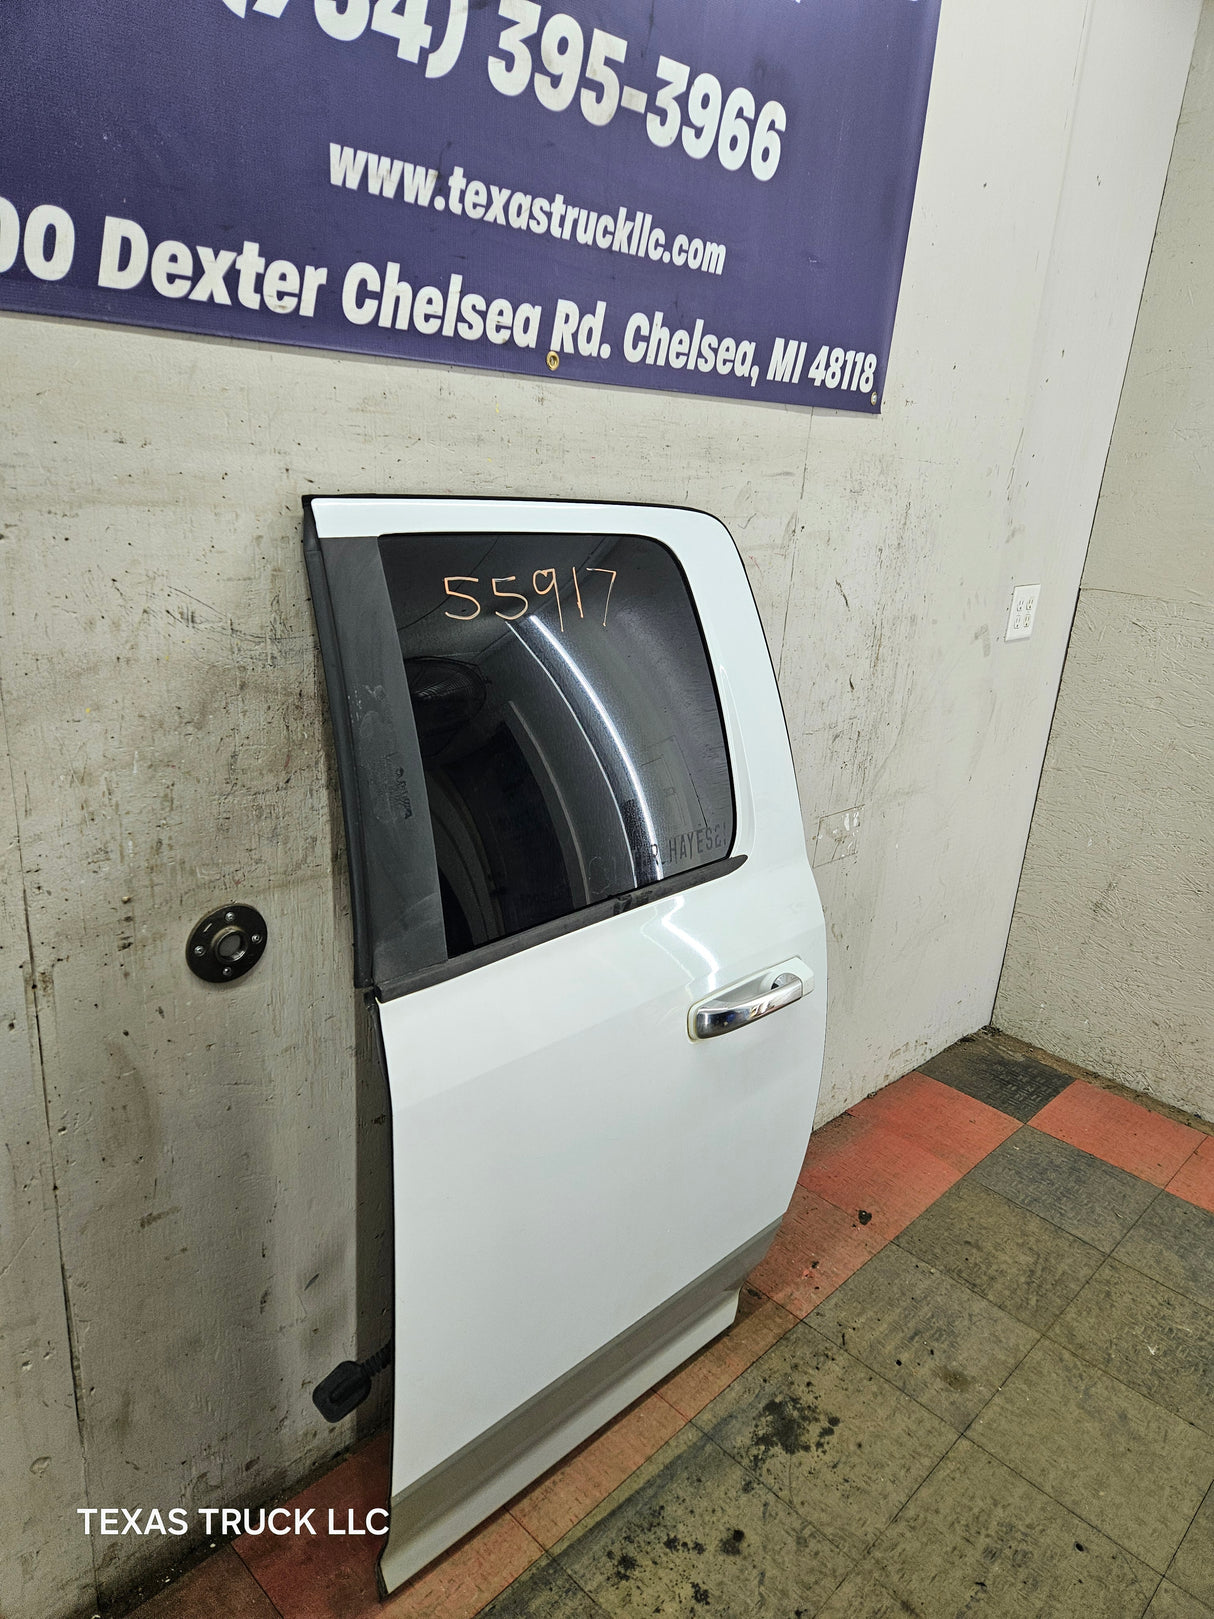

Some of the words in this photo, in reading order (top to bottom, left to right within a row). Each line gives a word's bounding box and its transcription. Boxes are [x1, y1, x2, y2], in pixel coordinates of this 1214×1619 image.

[488, 0, 787, 181] 395-3966
[329, 142, 727, 276] www.texastruckllc.com
[98, 216, 328, 317] Dexter
[341, 261, 542, 348] Chelsea
[550, 298, 612, 360] Rd.
[623, 311, 760, 387] Chelsea,
[766, 337, 808, 384] MI
[808, 345, 878, 394] 48118
[443, 566, 617, 633] 55917
